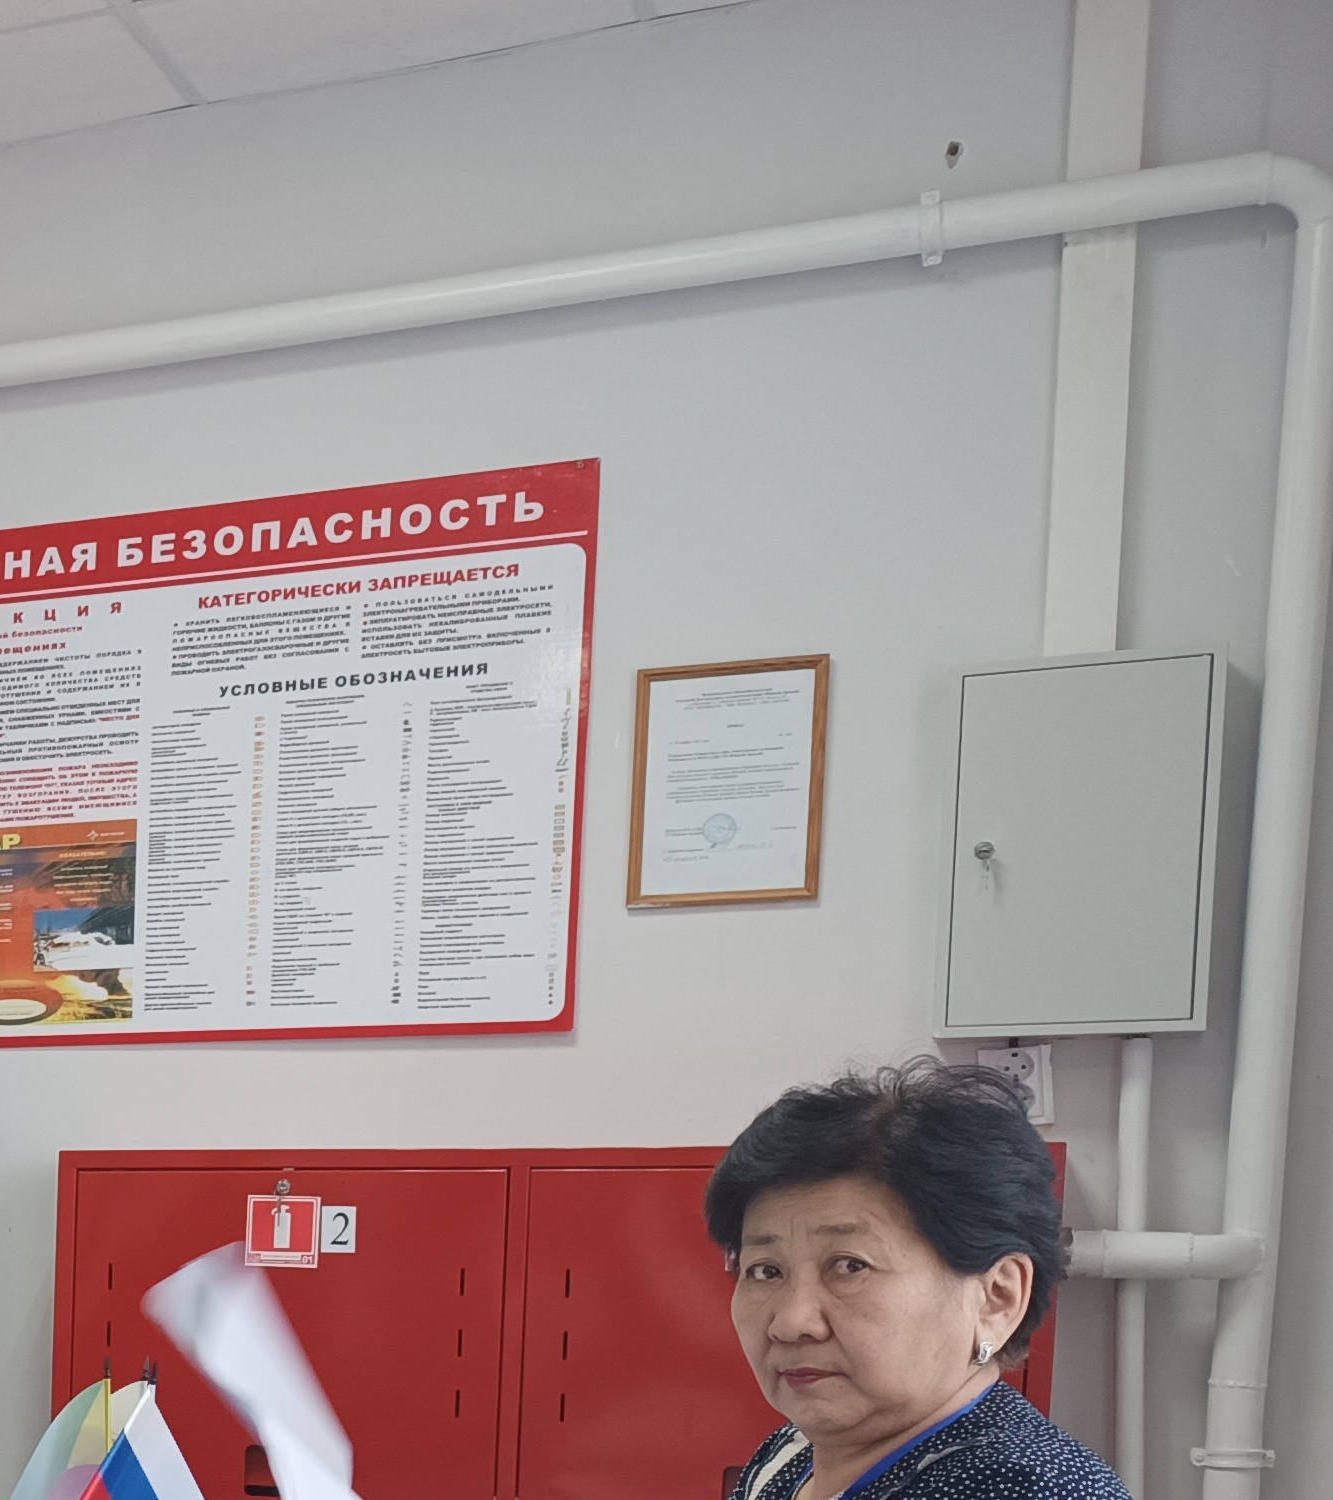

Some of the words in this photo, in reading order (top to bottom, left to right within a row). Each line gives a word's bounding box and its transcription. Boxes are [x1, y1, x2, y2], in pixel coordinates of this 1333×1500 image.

[117, 492, 546, 567] БЕЗОПАСНОСТЬ
[198, 581, 361, 609] КАТЕГОРИЧЕСКИ
[368, 564, 519, 592] ЗАПРЕЩАЕТСЯ
[219, 677, 328, 698] УСЛОВНЫЕ
[335, 663, 488, 688] ОБОЗНАЧЕНИЯ
[330, 1212, 349, 1246] 2
